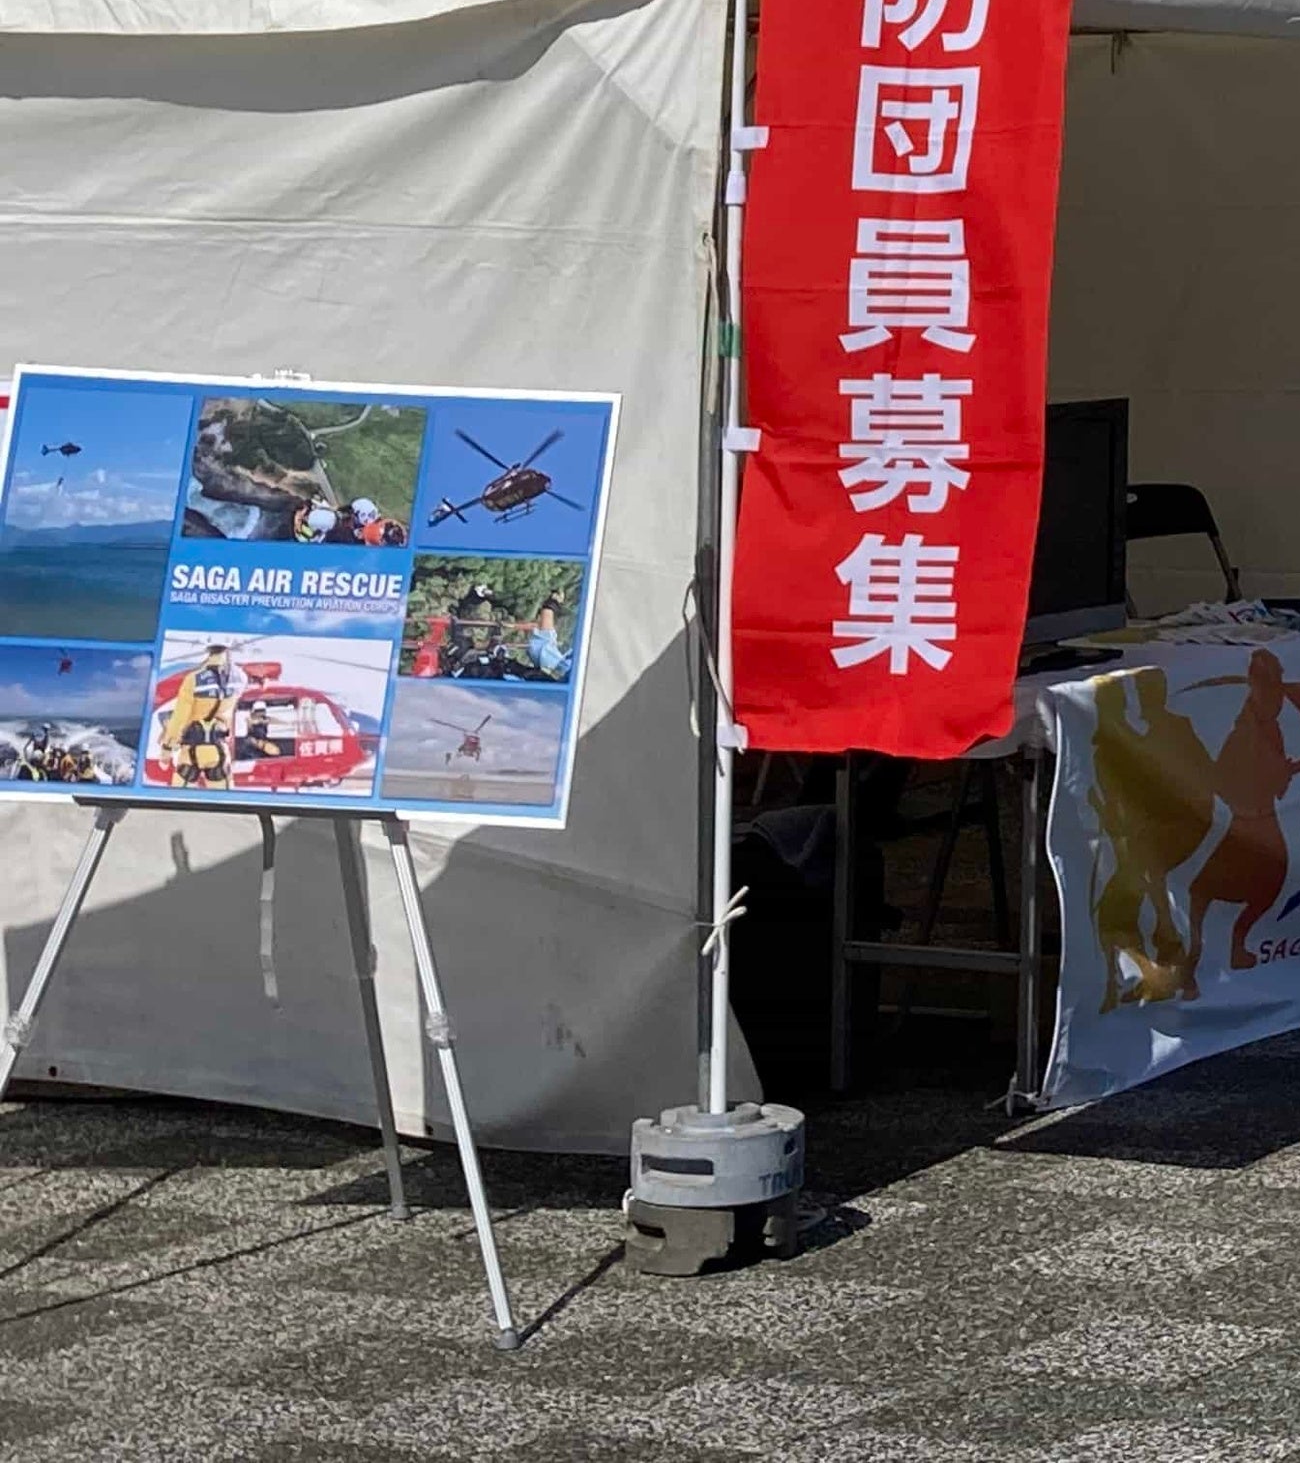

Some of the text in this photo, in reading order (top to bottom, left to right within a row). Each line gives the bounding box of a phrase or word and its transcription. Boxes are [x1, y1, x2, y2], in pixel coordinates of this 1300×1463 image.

[172, 564, 404, 599] SAGA AIR RESCUE
[169, 591, 198, 604] SAGA
[200, 593, 250, 607] DISASTER
[251, 595, 313, 610] PREVENTION
